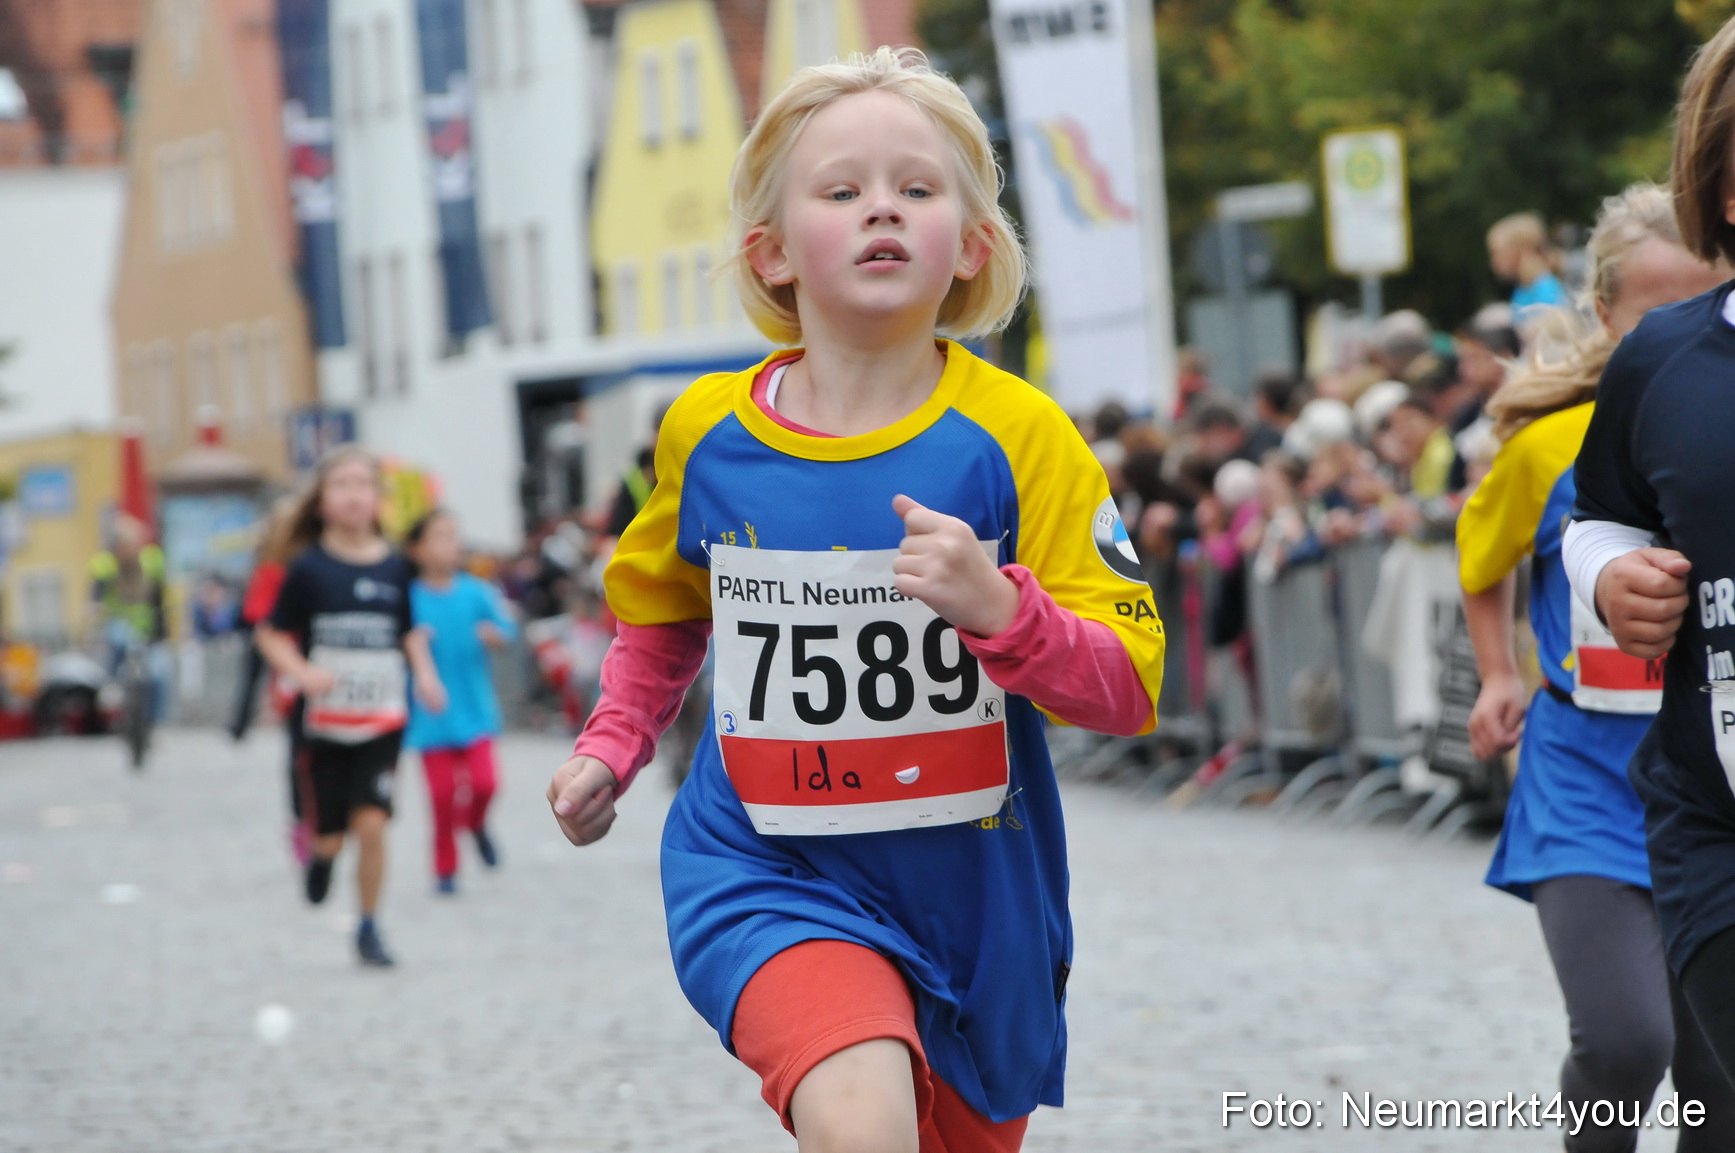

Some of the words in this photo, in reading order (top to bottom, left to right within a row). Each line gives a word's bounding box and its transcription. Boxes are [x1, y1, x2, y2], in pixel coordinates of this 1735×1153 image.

[718, 575, 795, 605] PARTL
[803, 581, 914, 606] Neuma
[737, 616, 979, 725] 7589
[723, 713, 735, 733] 3
[984, 701, 995, 718] K
[792, 744, 861, 792] Ida
